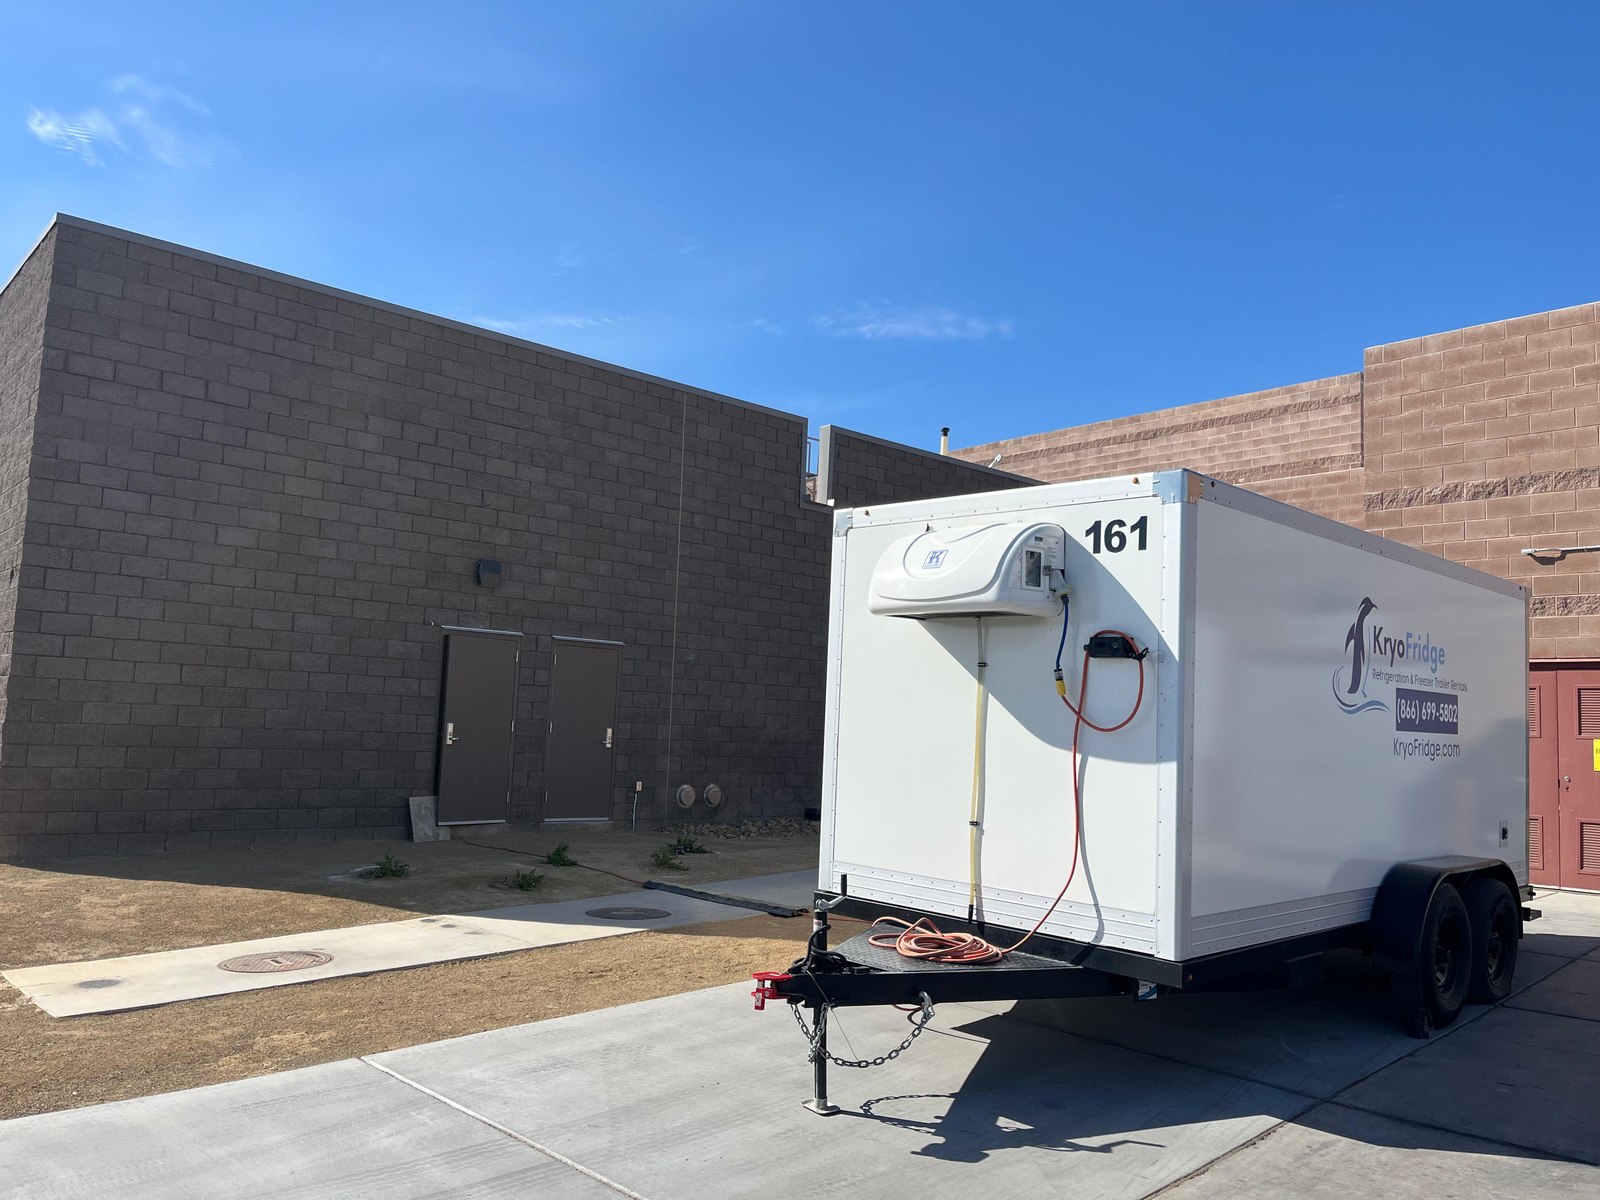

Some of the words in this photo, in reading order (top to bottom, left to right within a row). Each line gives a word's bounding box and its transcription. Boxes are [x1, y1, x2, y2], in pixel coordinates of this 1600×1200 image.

[1085, 515, 1148, 554] 161
[1373, 625, 1446, 674] KryoFridge
[1372, 668, 1410, 684] Refrigeration
[1410, 674, 1415, 685] &
[1414, 674, 1435, 688] Freezer
[1434, 677, 1451, 690] Trailer
[1450, 679, 1468, 692] Rentals
[1396, 698, 1420, 725] (866)
[1421, 701, 1458, 723] 699-5802
[1393, 738, 1461, 762] KryoFridge.com
